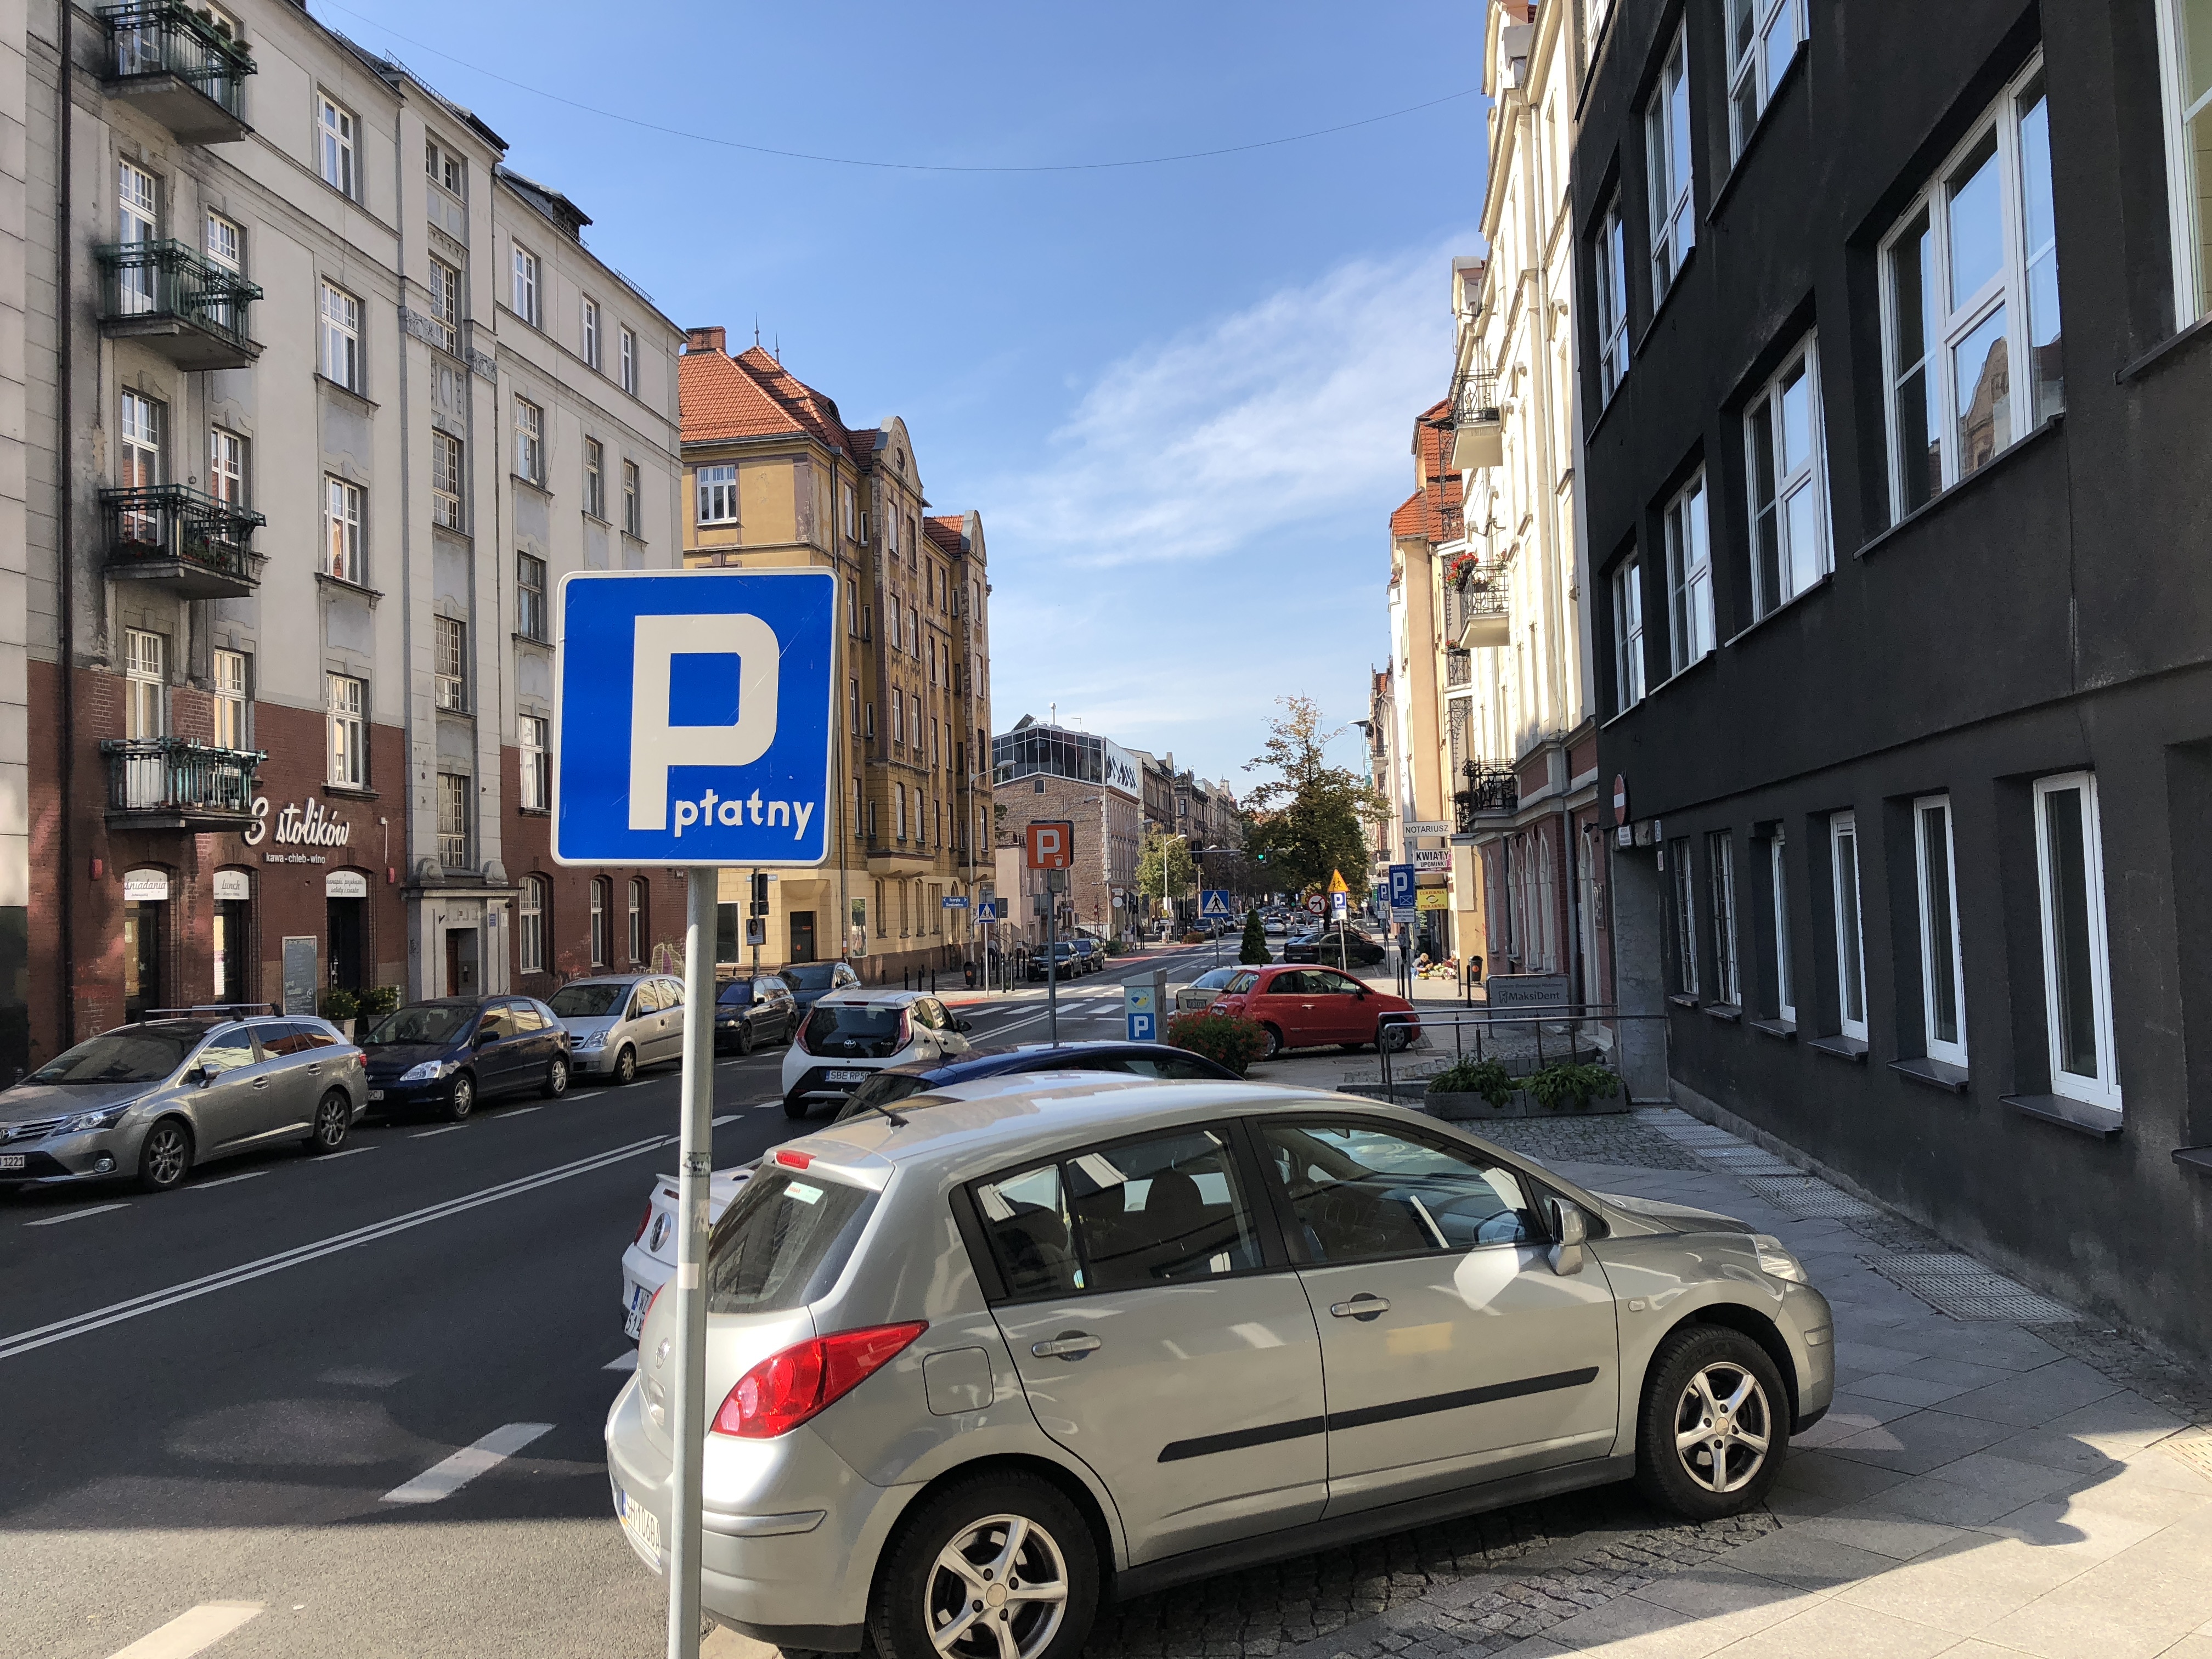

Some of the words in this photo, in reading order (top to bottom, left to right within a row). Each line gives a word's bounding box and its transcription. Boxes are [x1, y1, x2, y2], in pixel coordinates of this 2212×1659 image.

[629, 613, 780, 830] P
[245, 797, 269, 845] 3
[275, 797, 350, 847] stolików
[674, 788, 815, 840] płatny
[1406, 825, 1449, 834] NOTARIUSZ
[1037, 829, 1060, 864] P
[1416, 851, 1449, 861] KWIATY
[1392, 872, 1407, 899] P
[1334, 894, 1343, 908] P
[1509, 991, 1560, 1001] MaksiDent
[1134, 1015, 1149, 1037] P
[831, 1071, 848, 1080] SBE
[3, 1156, 24, 1167] 1221
[627, 1494, 635, 1527] SH
